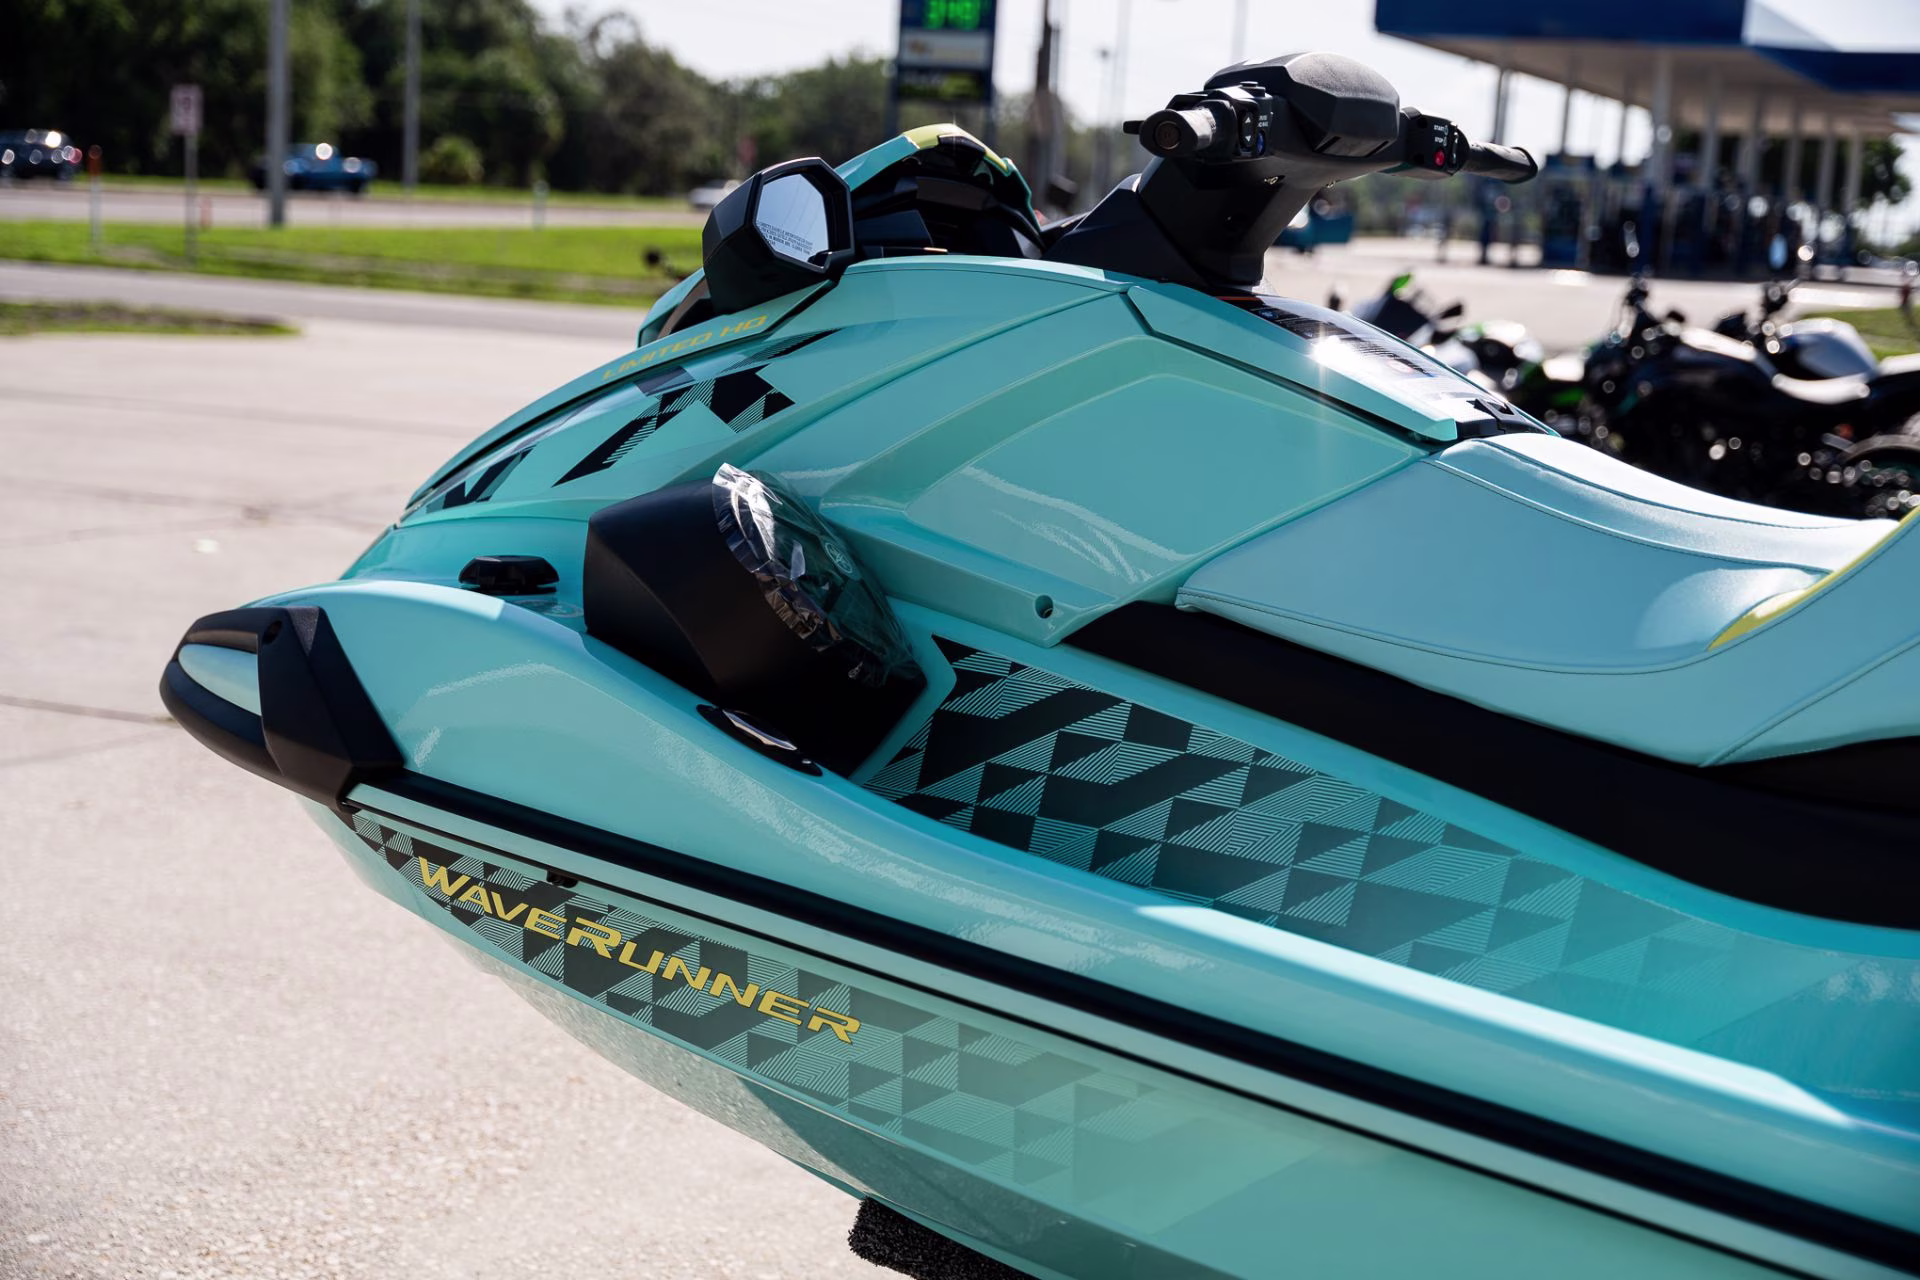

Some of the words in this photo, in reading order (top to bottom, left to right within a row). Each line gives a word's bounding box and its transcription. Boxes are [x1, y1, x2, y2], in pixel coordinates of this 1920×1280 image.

[603, 332, 713, 379] LIMITED
[720, 315, 767, 337] HD
[417, 855, 862, 1045] WAVERUNNER
